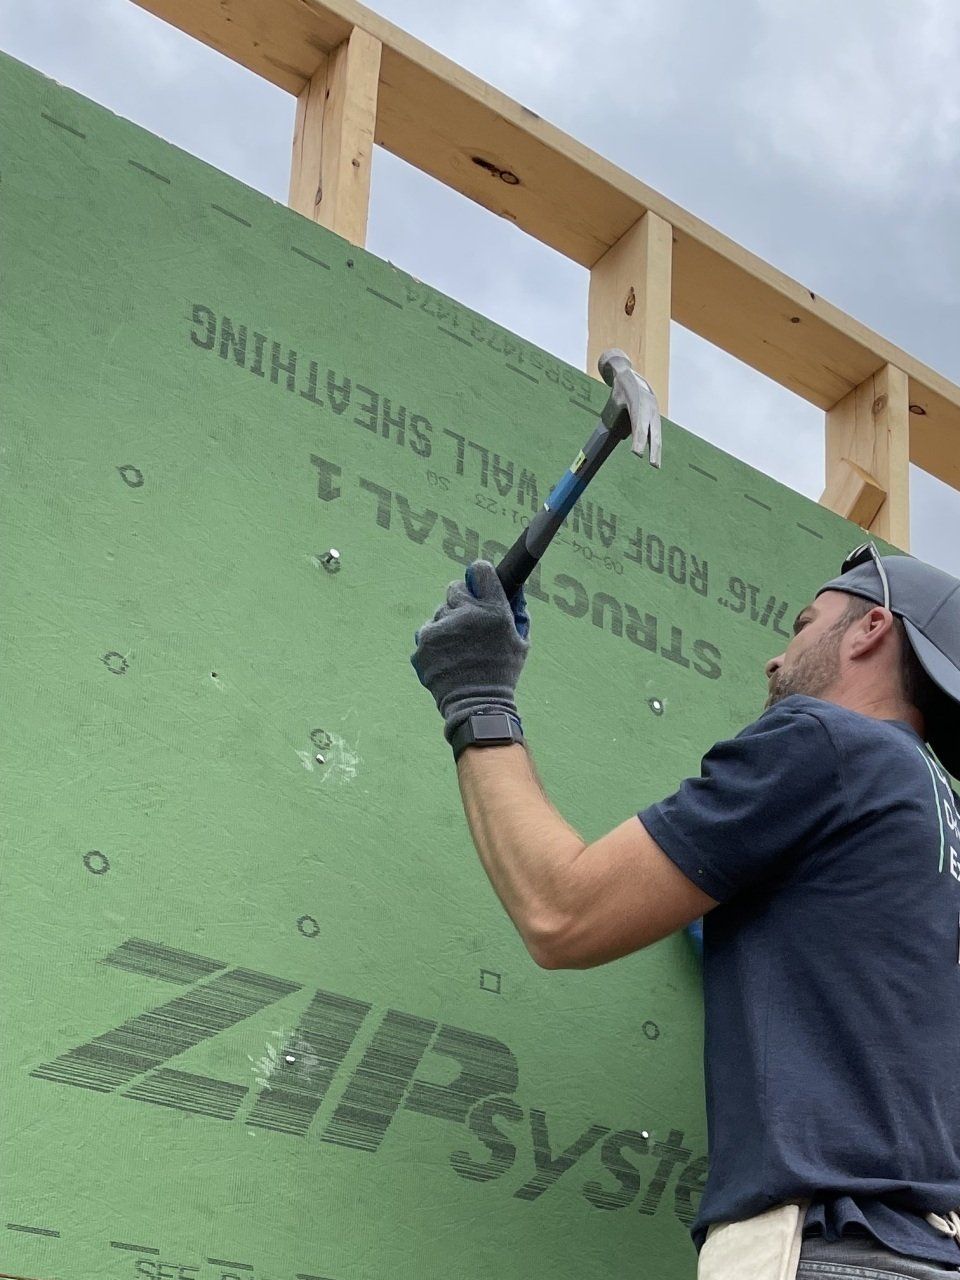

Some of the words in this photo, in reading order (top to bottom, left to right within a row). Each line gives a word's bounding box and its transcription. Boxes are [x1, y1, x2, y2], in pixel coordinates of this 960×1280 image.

[190, 303, 433, 459] SHEATHING
[309, 453, 342, 503] 1
[558, 494, 617, 549] AN
[623, 527, 708, 598] ROOF
[29, 937, 519, 1152] ZIP
[449, 1096, 709, 1229] syste
